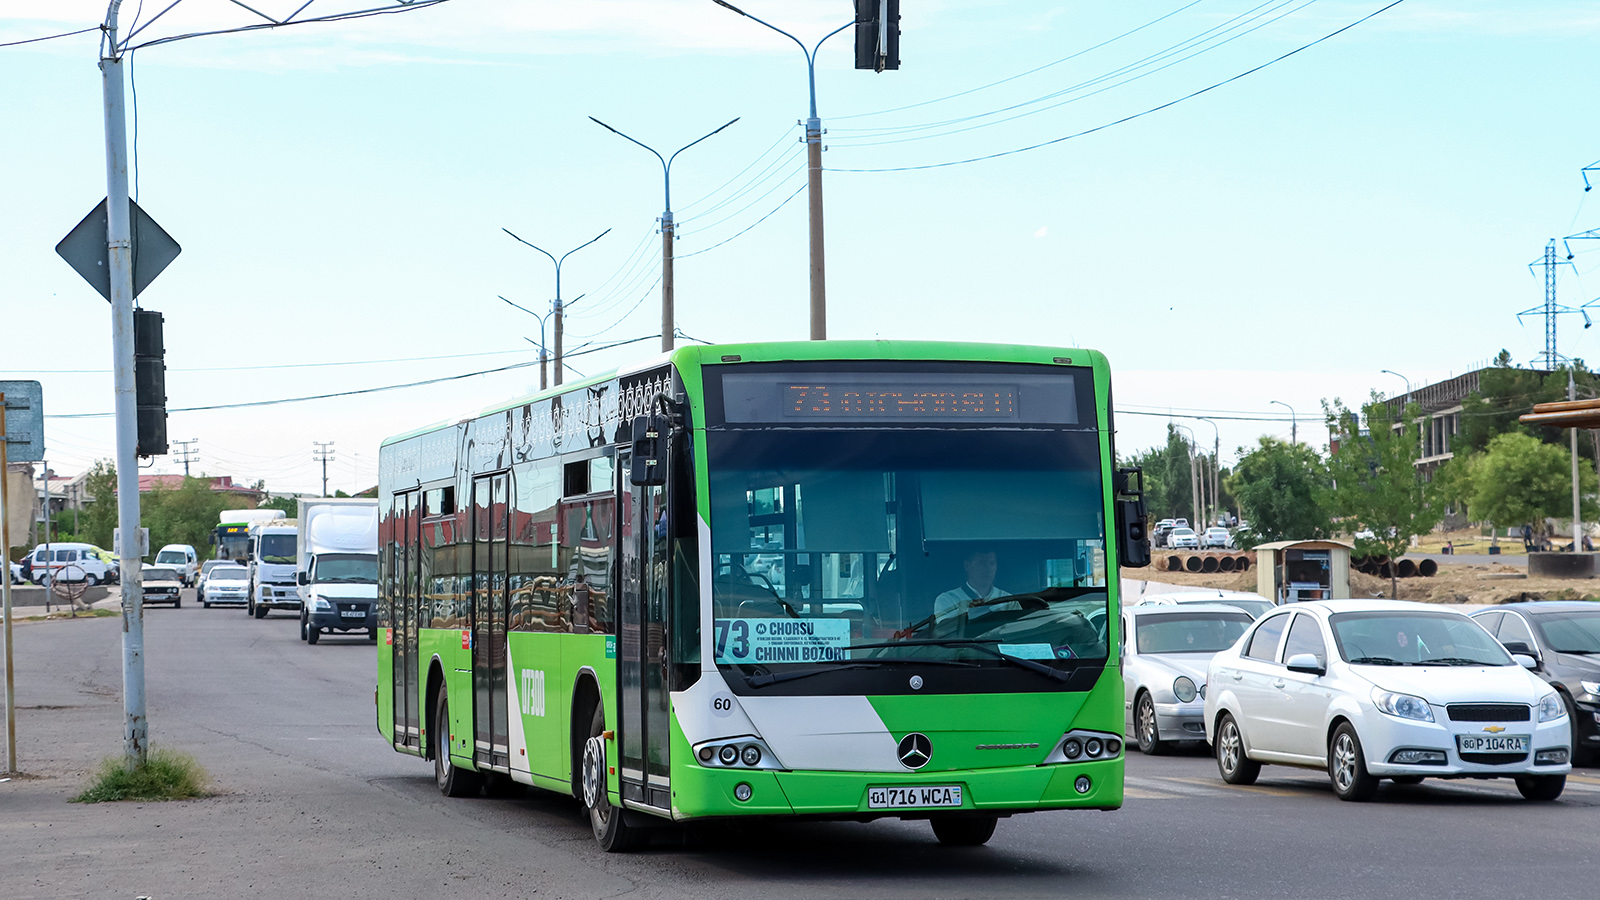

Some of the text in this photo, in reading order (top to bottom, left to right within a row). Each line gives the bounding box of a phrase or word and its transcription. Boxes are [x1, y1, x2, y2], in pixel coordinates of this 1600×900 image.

[769, 622, 814, 636] CHORSU
[715, 620, 750, 659] 73
[755, 647, 799, 661] CHINNI
[521, 668, 545, 717] 07300
[713, 697, 731, 711] 60
[872, 788, 952, 805] 01 716 WCA
